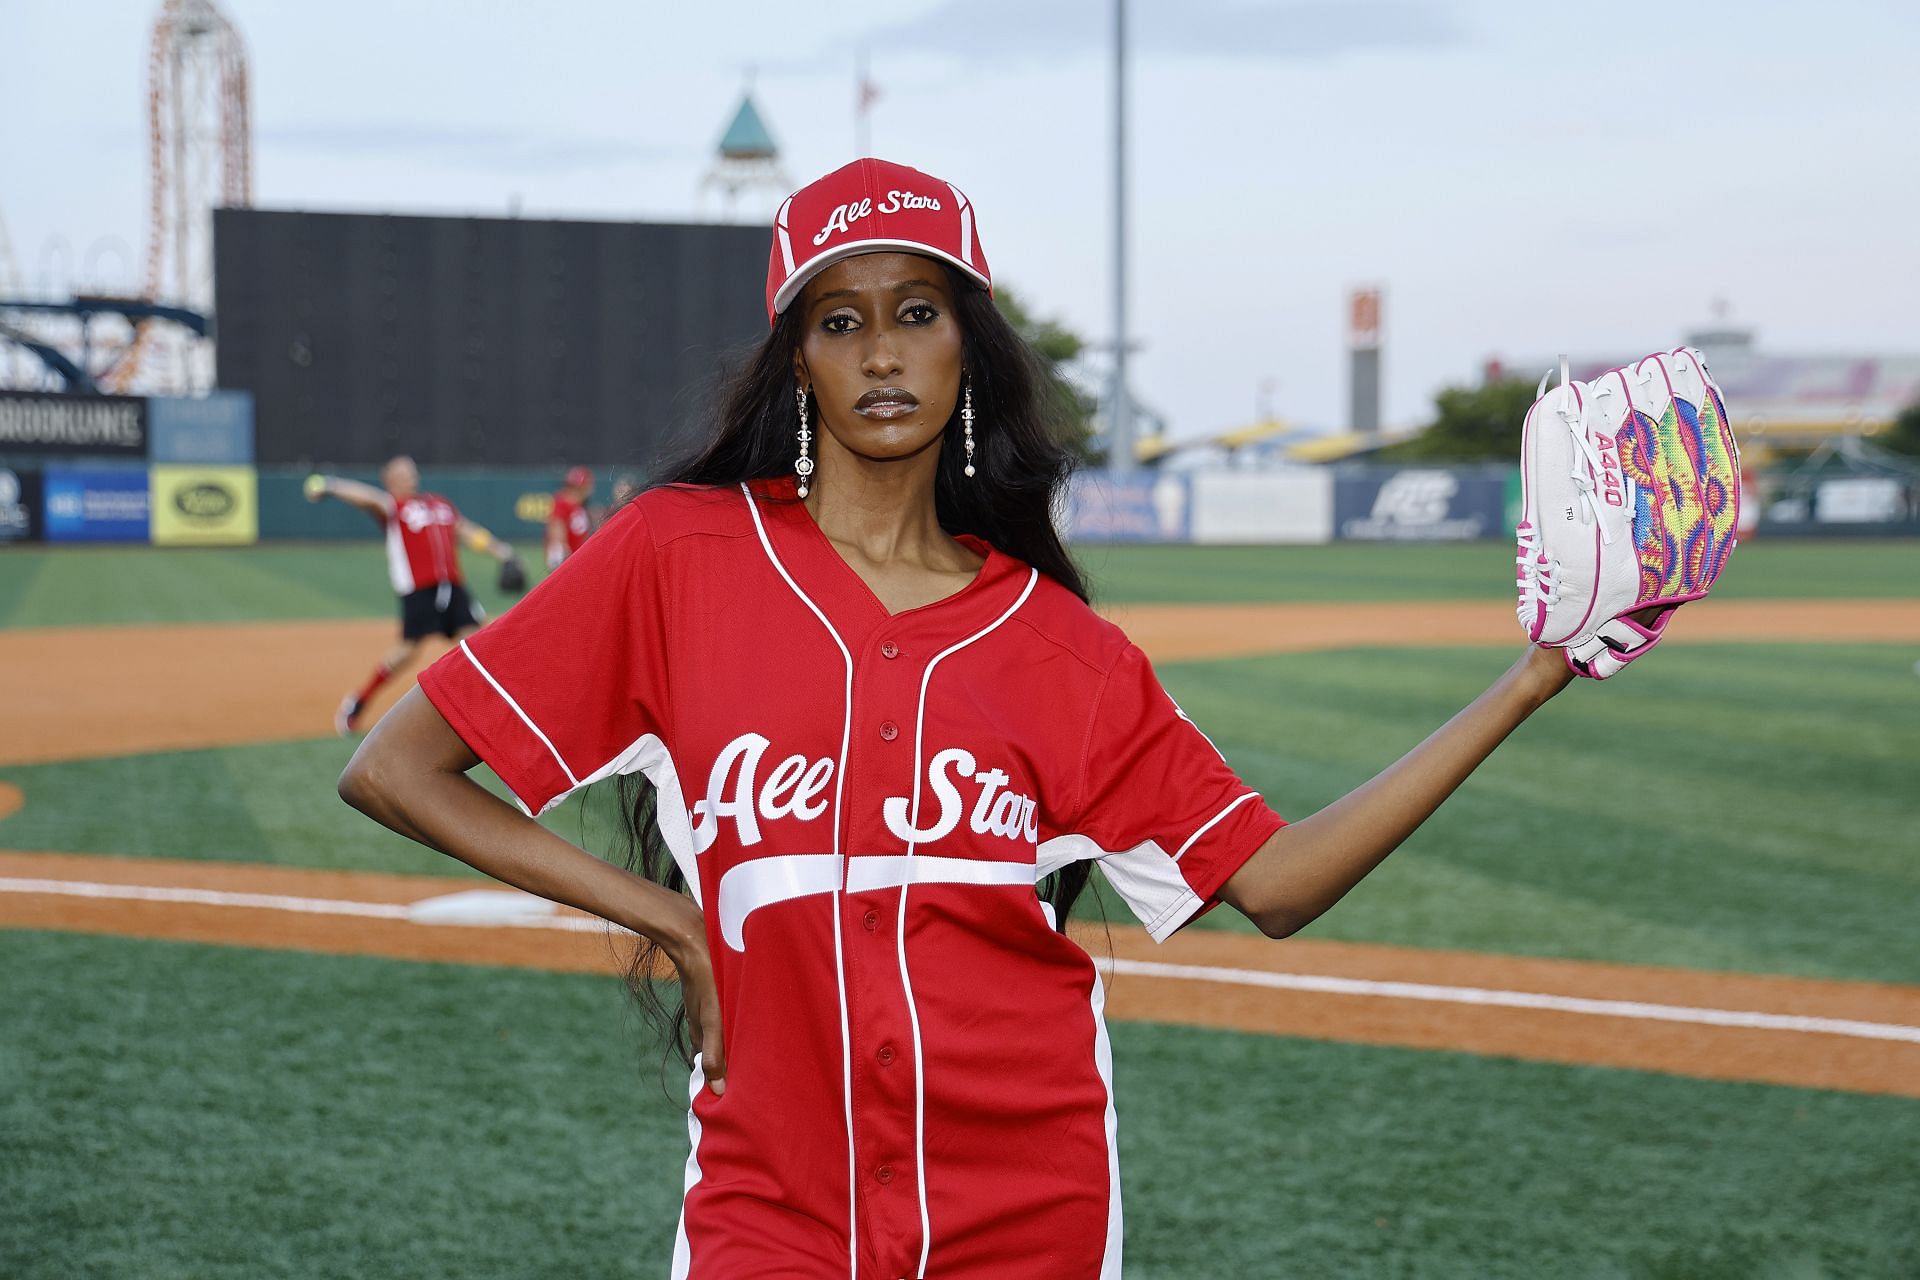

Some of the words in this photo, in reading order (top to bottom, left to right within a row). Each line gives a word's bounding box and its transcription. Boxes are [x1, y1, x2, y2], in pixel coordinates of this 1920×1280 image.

[813, 197, 872, 246] All
[878, 190, 941, 214] Stars
[1596, 431, 1622, 506] A440
[690, 732, 835, 855] All
[883, 748, 1038, 844] Star
